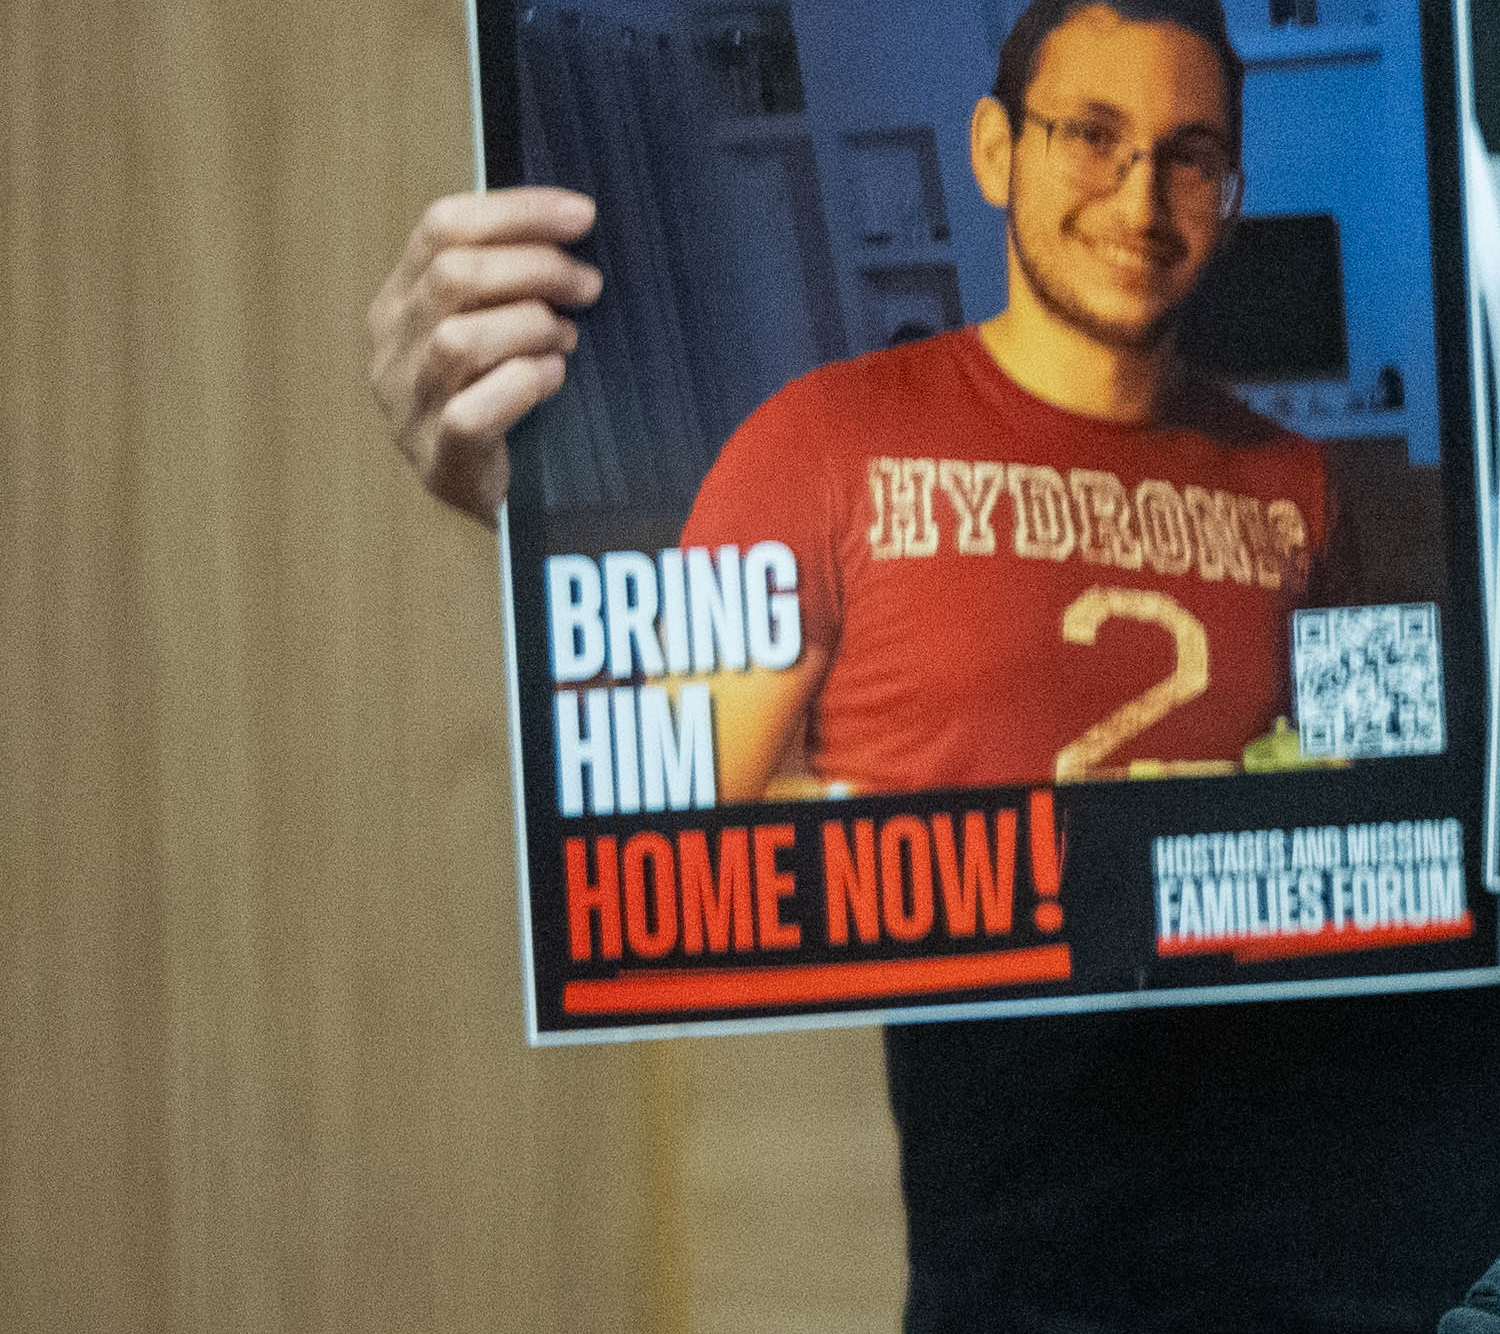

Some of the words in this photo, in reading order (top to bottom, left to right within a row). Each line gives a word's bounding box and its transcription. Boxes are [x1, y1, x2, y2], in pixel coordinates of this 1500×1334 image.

[545, 540, 802, 681] BRING
[1056, 587, 1232, 785] 2
[554, 682, 717, 818] HIM
[564, 824, 801, 962] HOME
[822, 789, 1065, 945] NOW!
